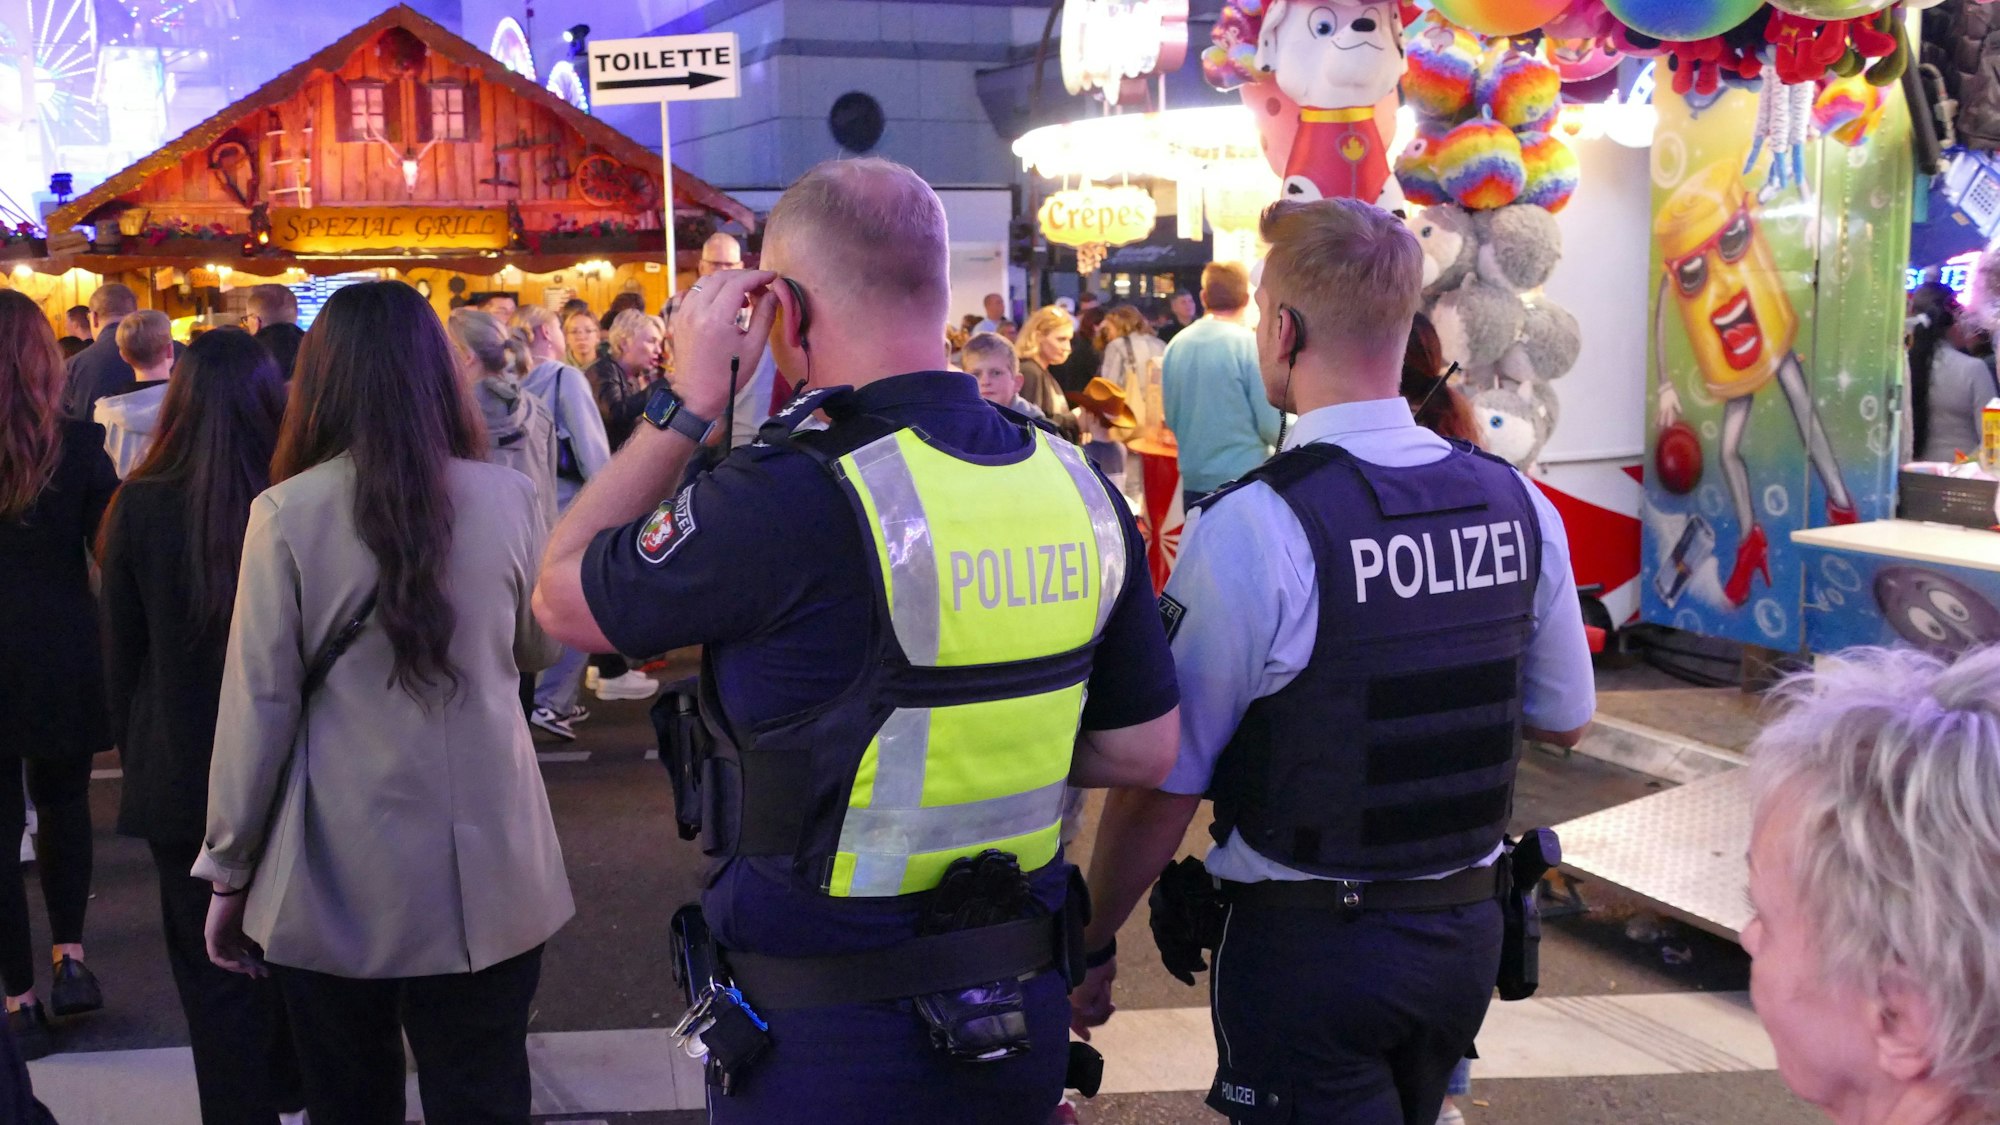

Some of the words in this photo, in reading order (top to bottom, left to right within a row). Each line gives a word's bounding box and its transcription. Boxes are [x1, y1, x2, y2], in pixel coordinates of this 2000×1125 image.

[594, 46, 731, 72] TOILETTE
[284, 214, 403, 241] SPEZIAL
[414, 214, 497, 241] GRILL
[1047, 197, 1146, 235] Crêpes
[950, 541, 1088, 611] POLIZEI
[1350, 519, 1527, 603] POLIZEI
[1221, 1081, 1256, 1106] POLIZEI
